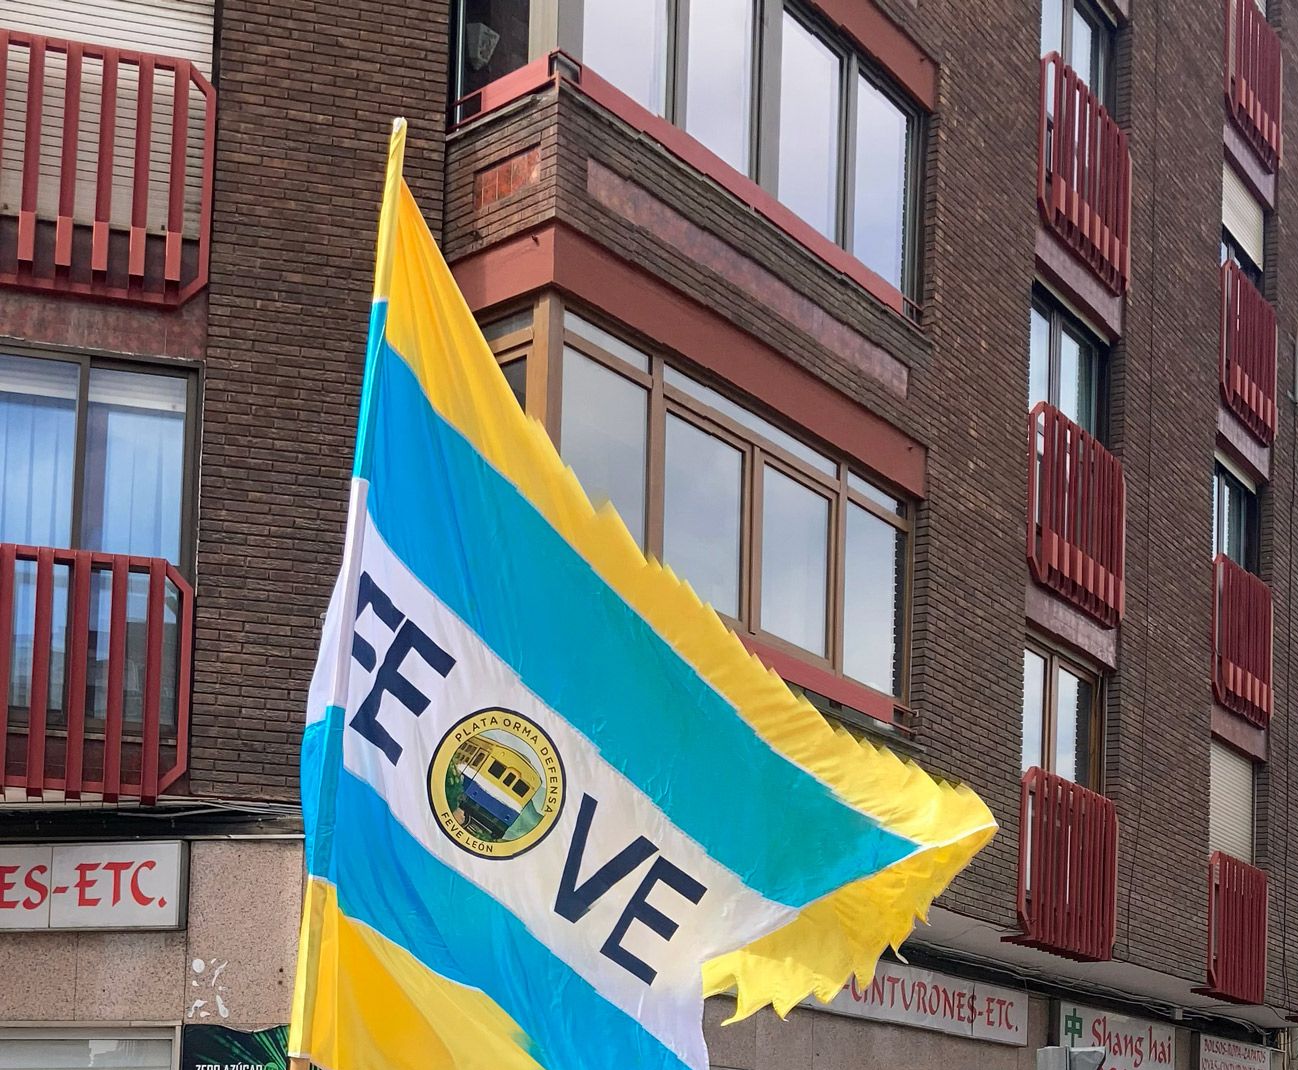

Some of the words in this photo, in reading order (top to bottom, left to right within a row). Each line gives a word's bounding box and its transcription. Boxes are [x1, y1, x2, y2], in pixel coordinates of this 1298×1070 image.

[540, 747, 559, 814] DEFENSA
[441, 811, 465, 839] FEVE
[465, 838, 494, 853] LEÓN
